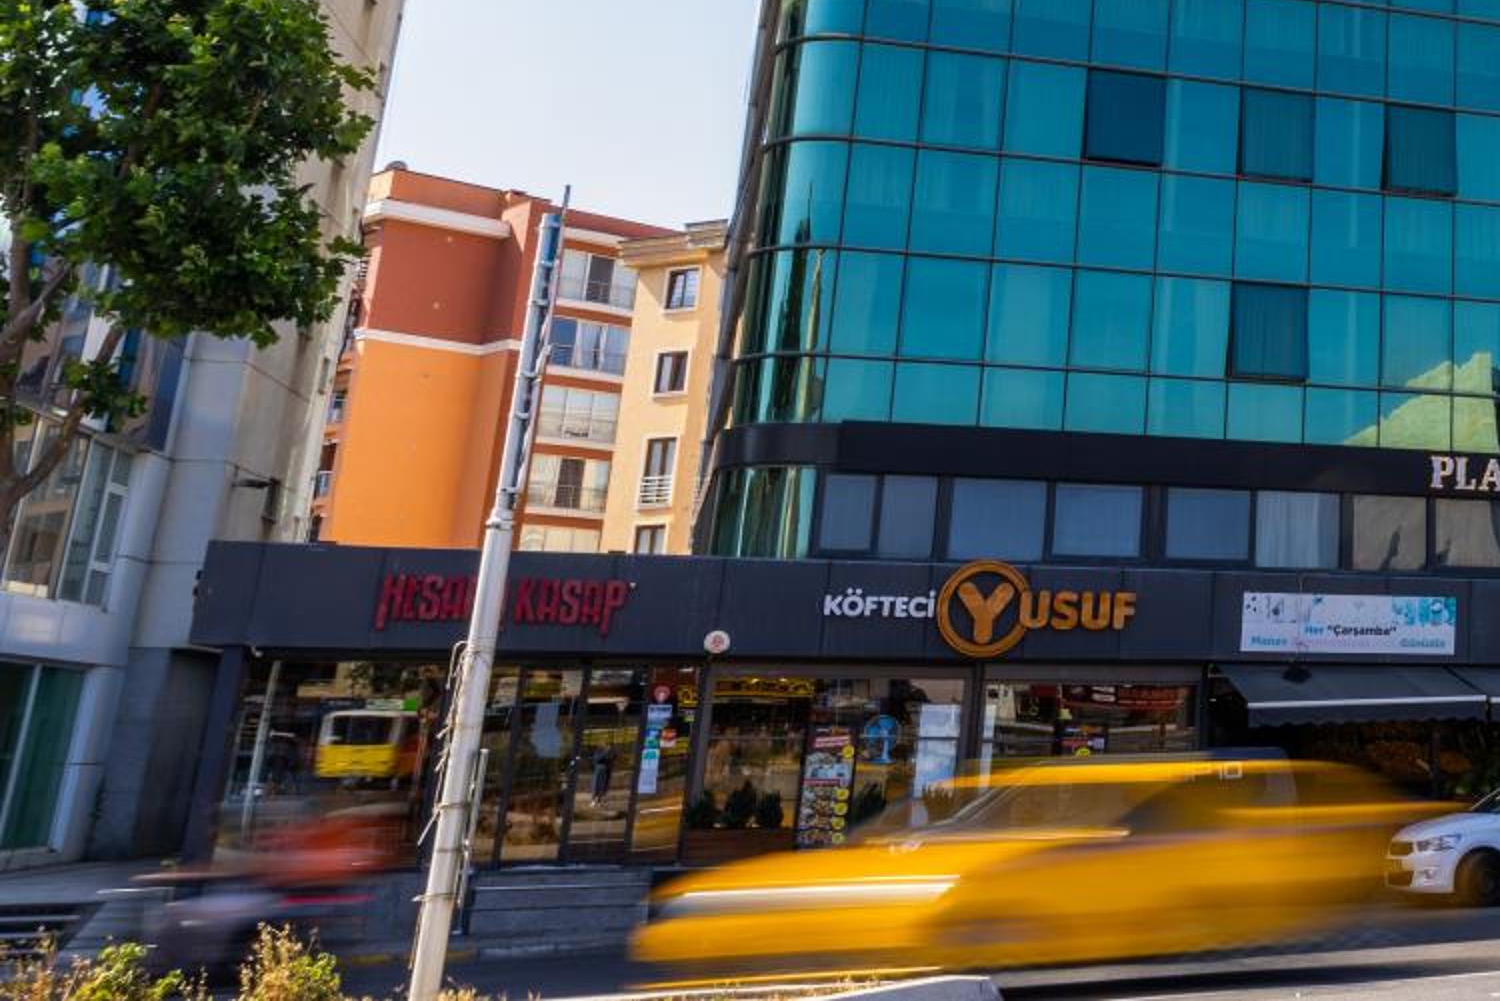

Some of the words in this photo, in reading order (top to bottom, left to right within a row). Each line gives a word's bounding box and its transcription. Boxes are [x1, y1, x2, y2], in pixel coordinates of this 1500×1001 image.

[513, 576, 629, 637] KASAP
[822, 587, 936, 619] KÖFTECİ
[956, 581, 1138, 645] YUSUF
